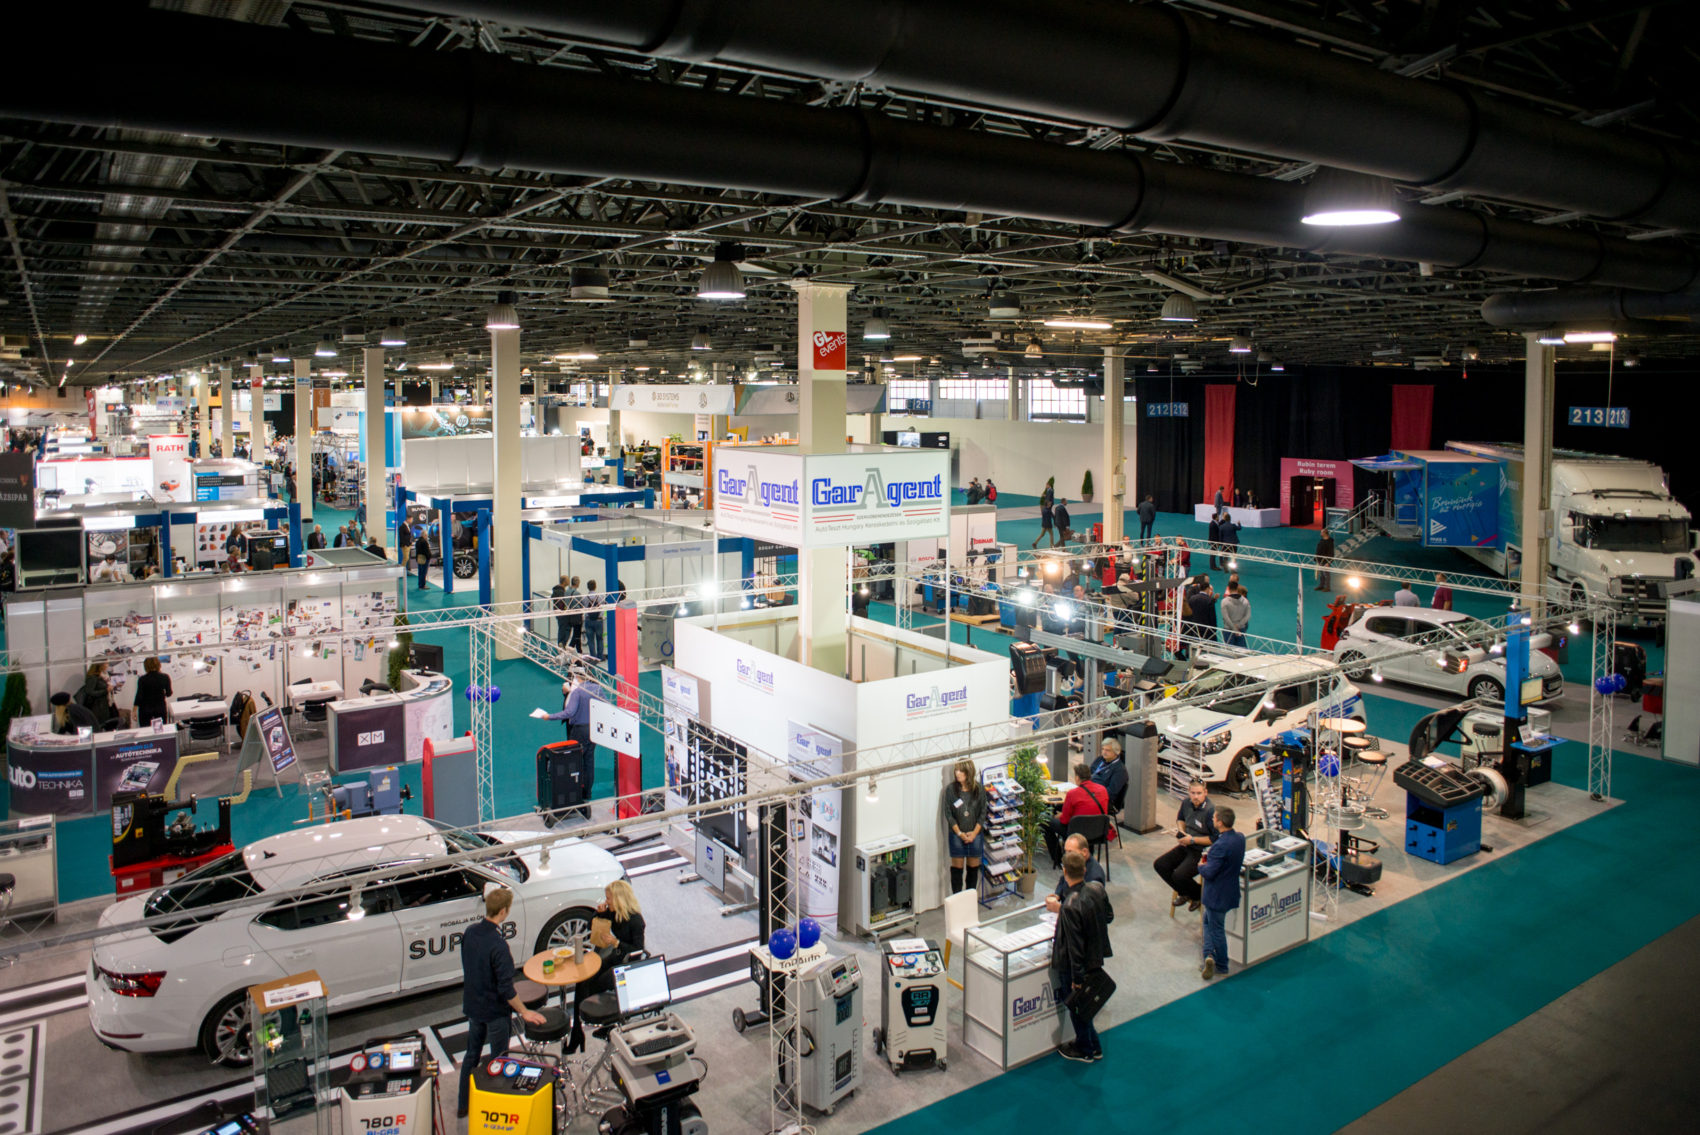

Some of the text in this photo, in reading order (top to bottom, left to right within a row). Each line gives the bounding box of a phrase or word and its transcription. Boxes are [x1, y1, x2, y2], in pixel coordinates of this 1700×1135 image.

[814, 331, 833, 347] GL
[819, 334, 847, 357] events
[916, 400, 930, 409] 211
[1149, 405, 1168, 415] 212
[1572, 409, 1626, 424] 213 213
[156, 444, 184, 452] RATH
[719, 464, 799, 507] GarAgent
[812, 467, 942, 507] GarAgent
[667, 676, 690, 695] Gargent
[906, 685, 967, 709] GarAgent
[38, 780, 83, 790] TECHNIKA
[1251, 887, 1302, 921] GarAgent
[409, 920, 517, 960] SUPB
